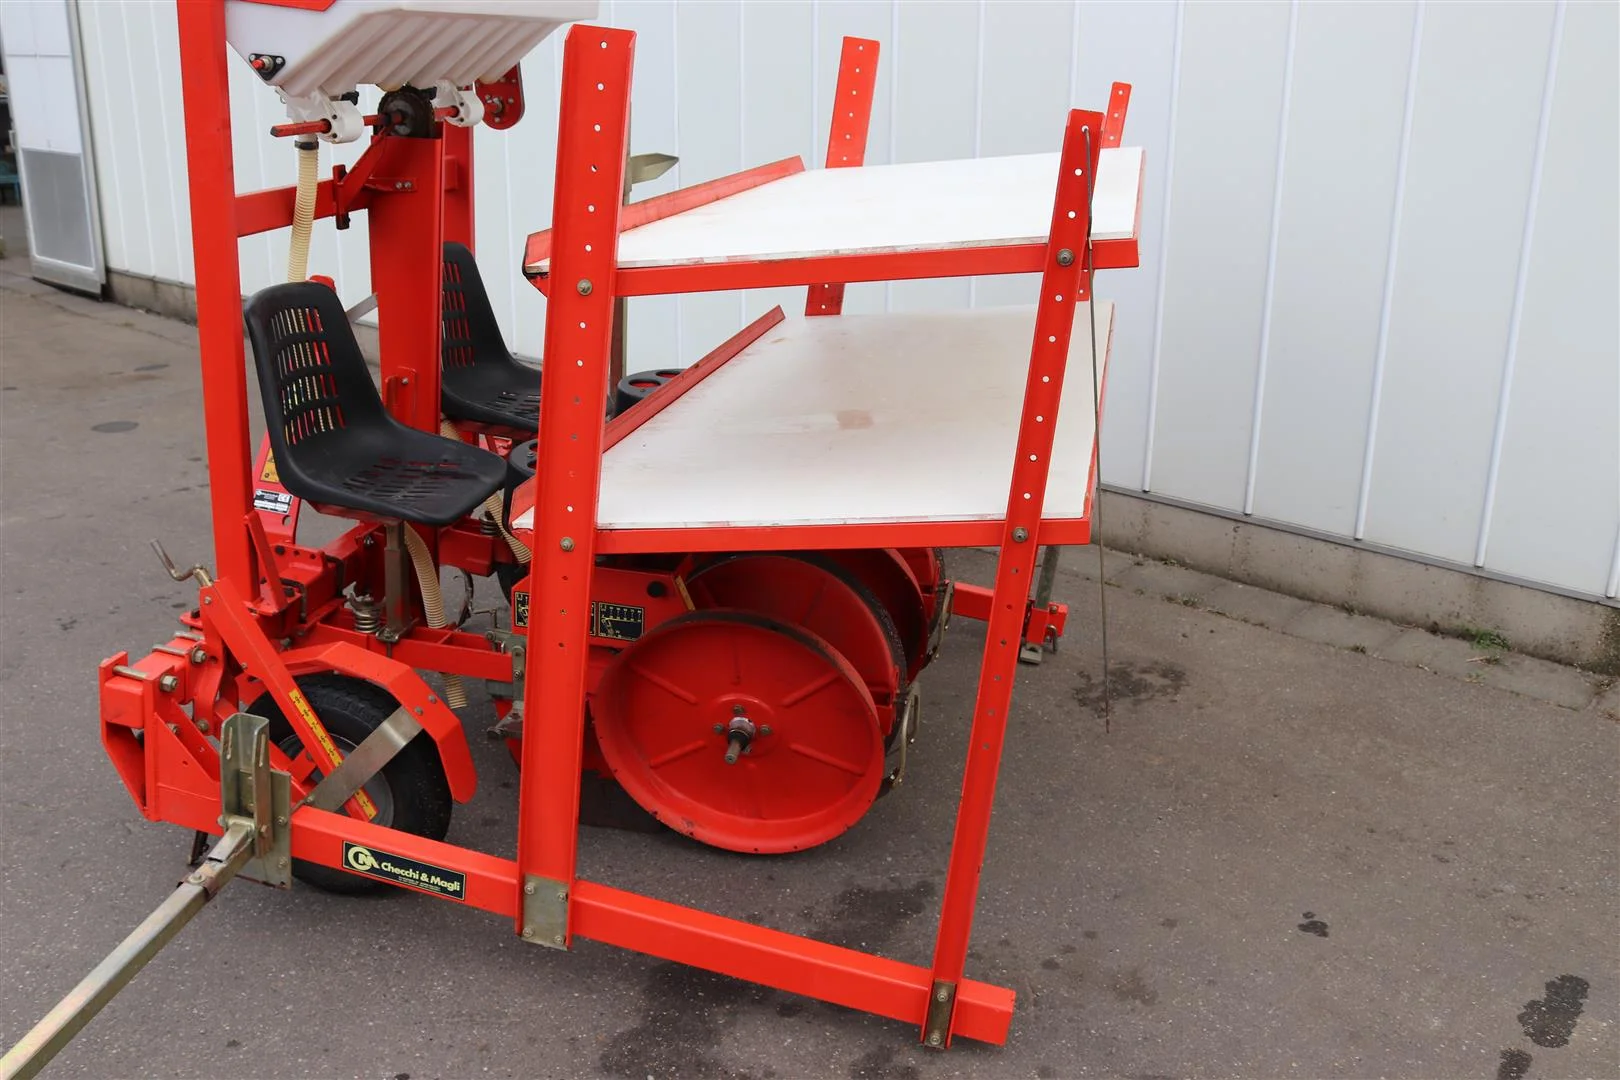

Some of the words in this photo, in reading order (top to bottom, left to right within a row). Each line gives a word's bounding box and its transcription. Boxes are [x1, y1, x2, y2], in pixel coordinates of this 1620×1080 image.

[381, 862, 419, 880] Checchi
[420, 872, 430, 883] &
[430, 876, 460, 892] Magli
